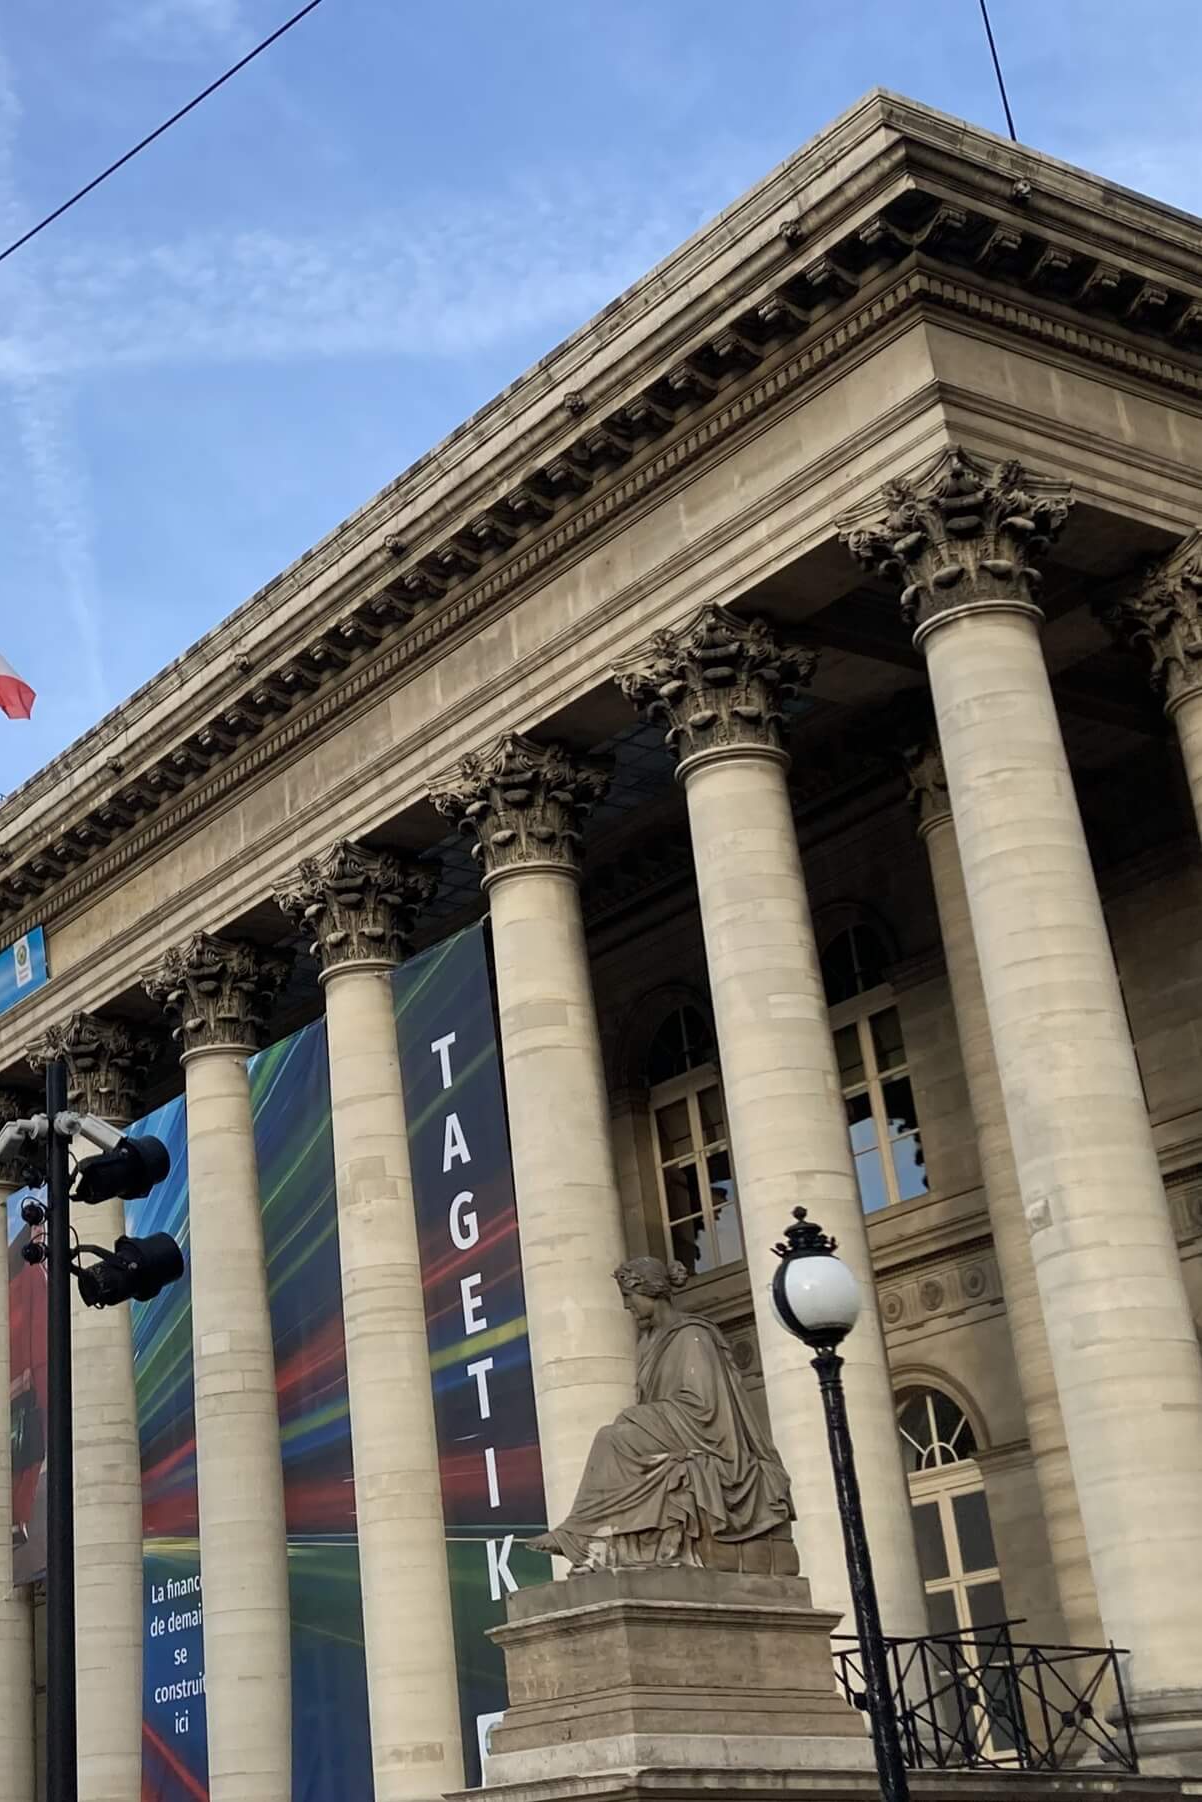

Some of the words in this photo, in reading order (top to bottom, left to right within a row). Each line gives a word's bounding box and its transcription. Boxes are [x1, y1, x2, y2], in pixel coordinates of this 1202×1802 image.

[430, 1031, 519, 1600] TAGETIK
[152, 1585, 164, 1604] La
[167, 1575, 203, 1600] financ
[150, 1615, 165, 1637] de
[168, 1603, 202, 1633] demai
[174, 1648, 188, 1665] se
[175, 1710, 189, 1734] ici
